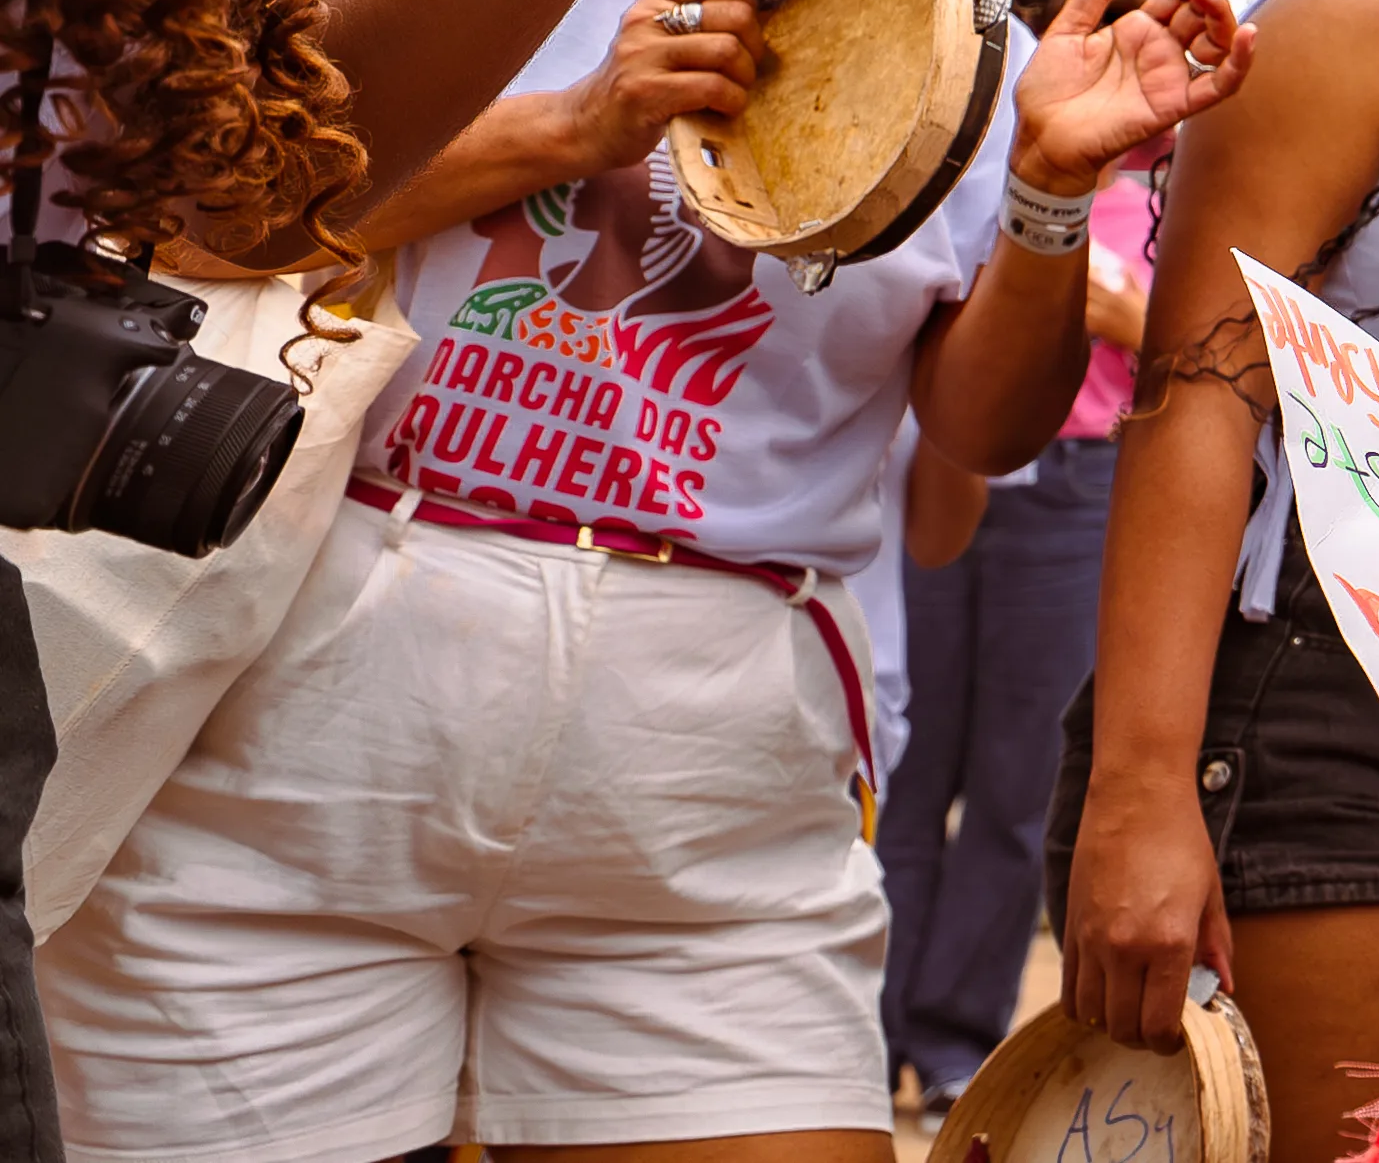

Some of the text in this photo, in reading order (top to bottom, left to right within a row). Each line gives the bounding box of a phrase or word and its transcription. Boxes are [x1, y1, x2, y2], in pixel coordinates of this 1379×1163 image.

[384, 392, 706, 521] MULHERES
[422, 337, 722, 462] MARCHA DAS
